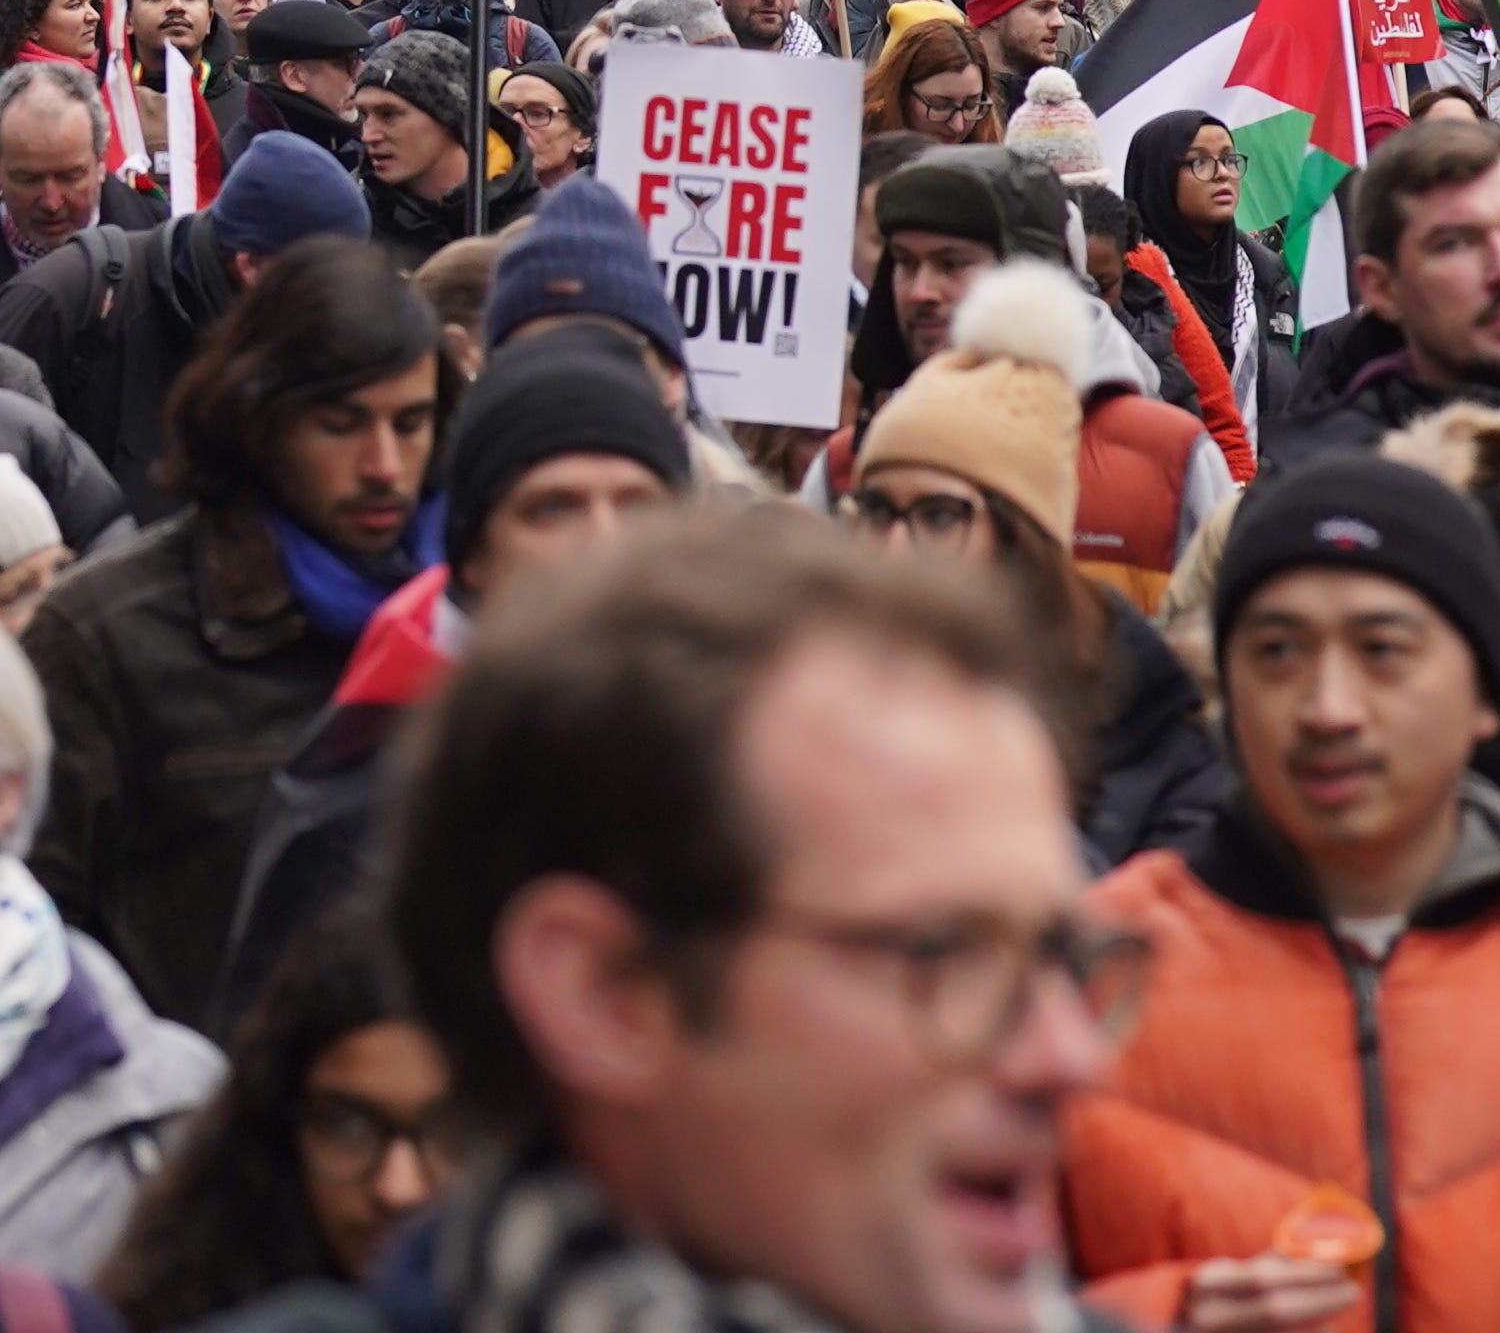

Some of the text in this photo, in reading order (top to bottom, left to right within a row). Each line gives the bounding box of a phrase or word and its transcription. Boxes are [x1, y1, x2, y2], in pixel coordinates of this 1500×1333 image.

[643, 95, 812, 173] CEASE
[637, 171, 808, 264] FRE
[656, 261, 800, 346] OW!
